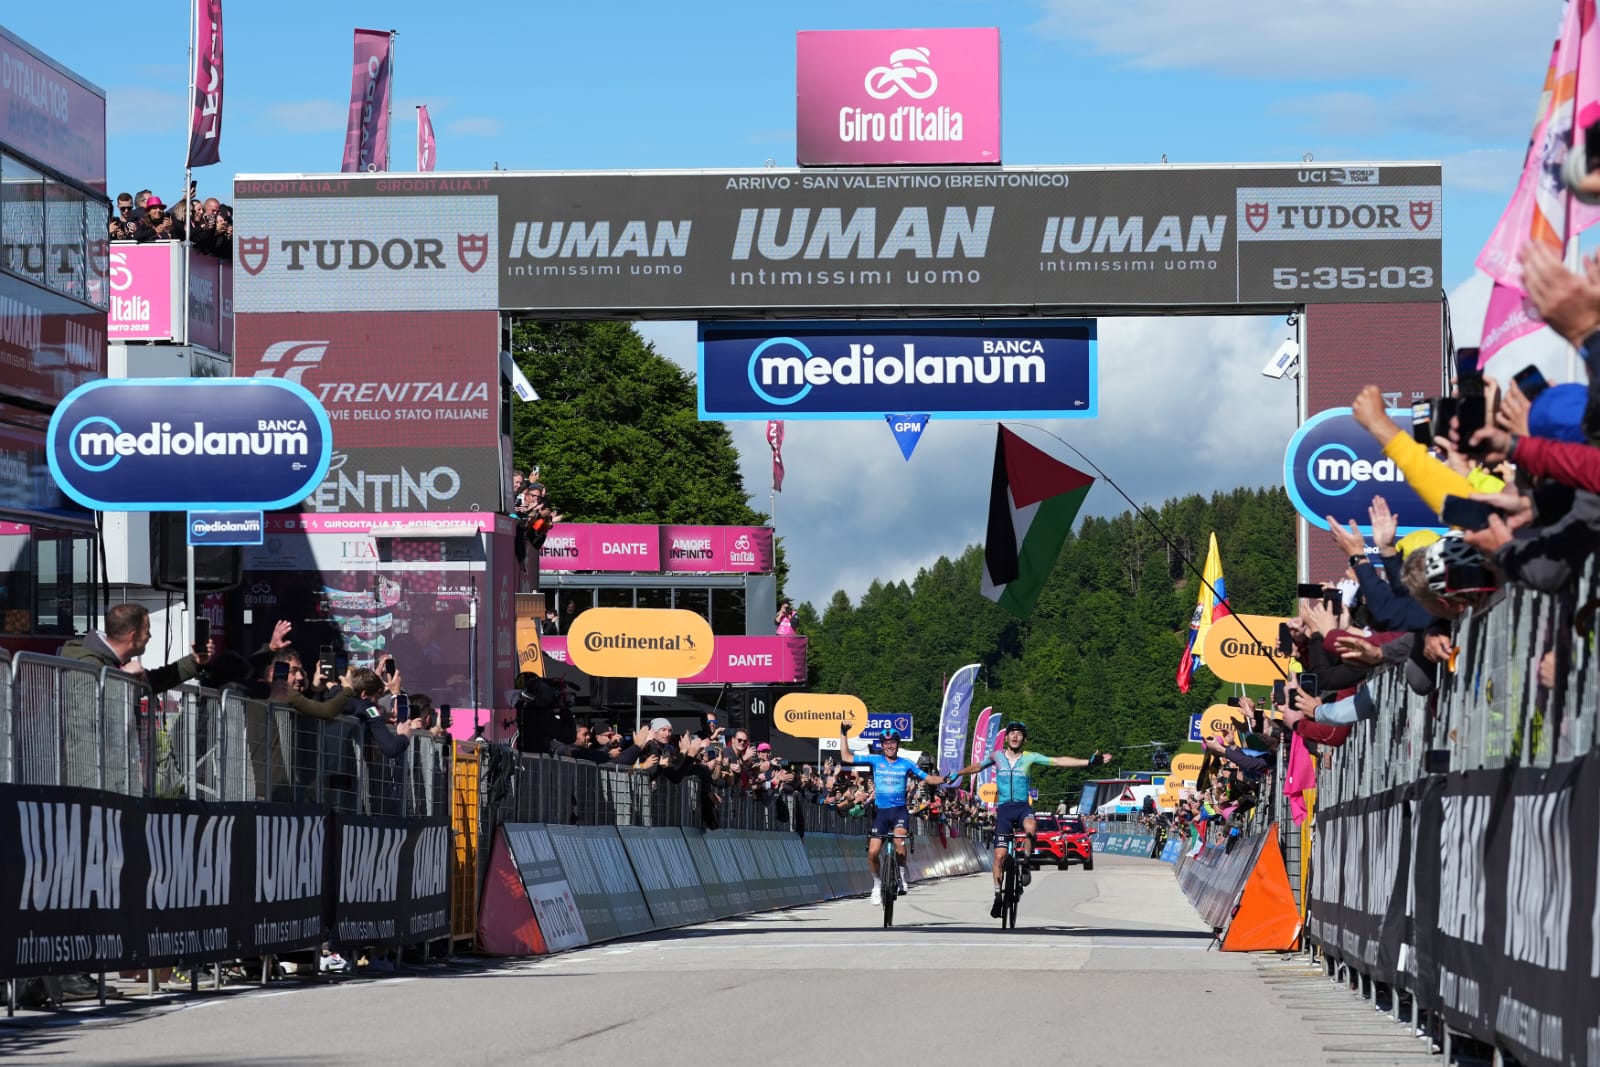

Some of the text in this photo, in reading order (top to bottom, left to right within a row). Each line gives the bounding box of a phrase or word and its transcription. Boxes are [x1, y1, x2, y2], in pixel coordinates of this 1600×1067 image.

[839, 106, 963, 142] Giro d'Italia
[726, 177, 790, 190] ARRIVO
[803, 177, 840, 189] SAN
[842, 175, 942, 188] VALENTINO
[944, 174, 1069, 188] (BRENTONICO)
[1298, 170, 1327, 183] UCI
[235, 179, 491, 194] GIRODITALIA.IT GIRODITALIA.IT
[1277, 204, 1401, 229] TUDOR
[508, 206, 1227, 261] IUMAN IUMAN IUMAN
[281, 237, 446, 271] TUDOR
[508, 263, 683, 276] intimissimi uomo
[1040, 259, 1217, 271] intimissimi uomo
[731, 269, 980, 285] intimissimi uomo
[1273, 266, 1434, 290] 5:35:03
[982, 340, 1044, 354] BANCA
[761, 343, 1046, 386] mediolanum
[318, 382, 489, 403] TRENITALIA
[354, 409, 391, 420] DELLO
[394, 409, 431, 420] STATO
[435, 408, 489, 419] ITALIANE
[258, 420, 307, 431] BANCA
[895, 422, 921, 433] GPM
[80, 422, 308, 456] mediolanum
[304, 464, 461, 512] ENTINO
[194, 521, 260, 532] mediolanum
[544, 537, 576, 547] MORE
[602, 543, 648, 555] DANTE
[672, 540, 711, 549] AMORE
[669, 549, 714, 559] INFINITO
[584, 631, 681, 652] Continental
[728, 655, 773, 666] DANTE
[650, 681, 666, 692] 10
[784, 709, 846, 722] Continental
[17, 800, 327, 911] IUMAN IUMAN IUMAN
[339, 825, 407, 903] IUMAN
[203, 927, 229, 951] uomo
[95, 934, 123, 960] uomo
